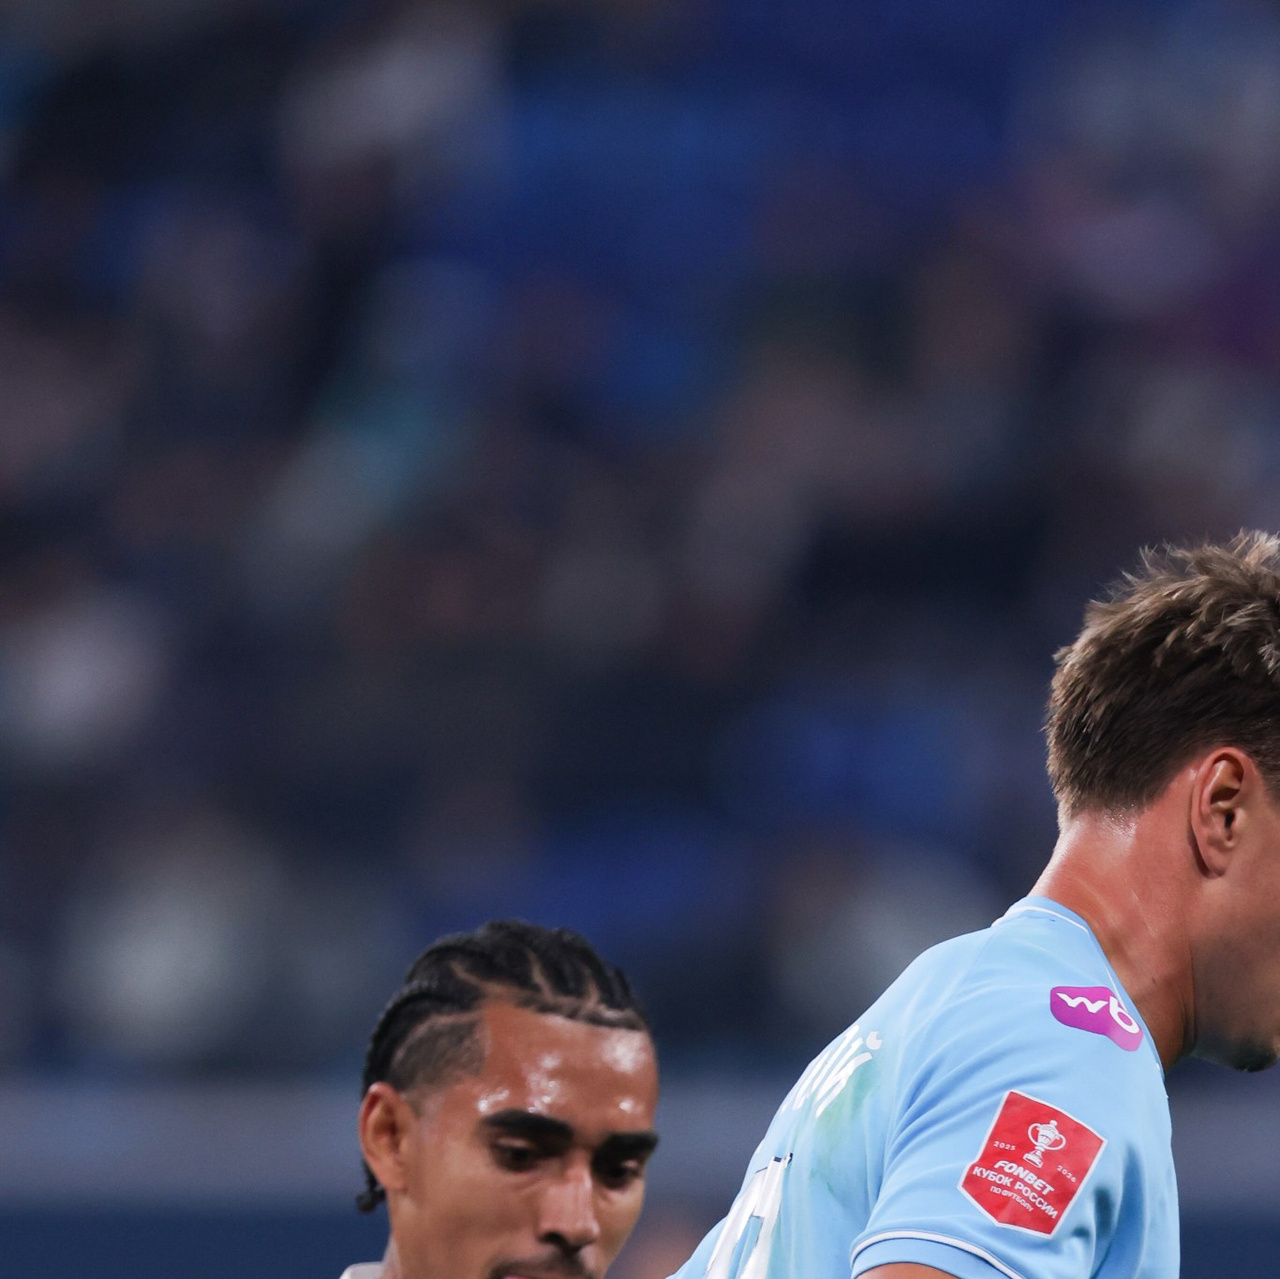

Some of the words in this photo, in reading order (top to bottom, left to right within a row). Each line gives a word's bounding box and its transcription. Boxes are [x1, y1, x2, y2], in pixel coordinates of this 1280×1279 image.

[993, 1140, 1016, 1151] 2025
[994, 1160, 1055, 1195] FONBET
[1056, 1164, 1076, 1183] 2026
[972, 1166, 1012, 1188] КУБОК
[1013, 1182, 1058, 1219] РОССИИ
[989, 1185, 1003, 1197] ПО
[1001, 1189, 1034, 1213] ФУТБОЛУ
